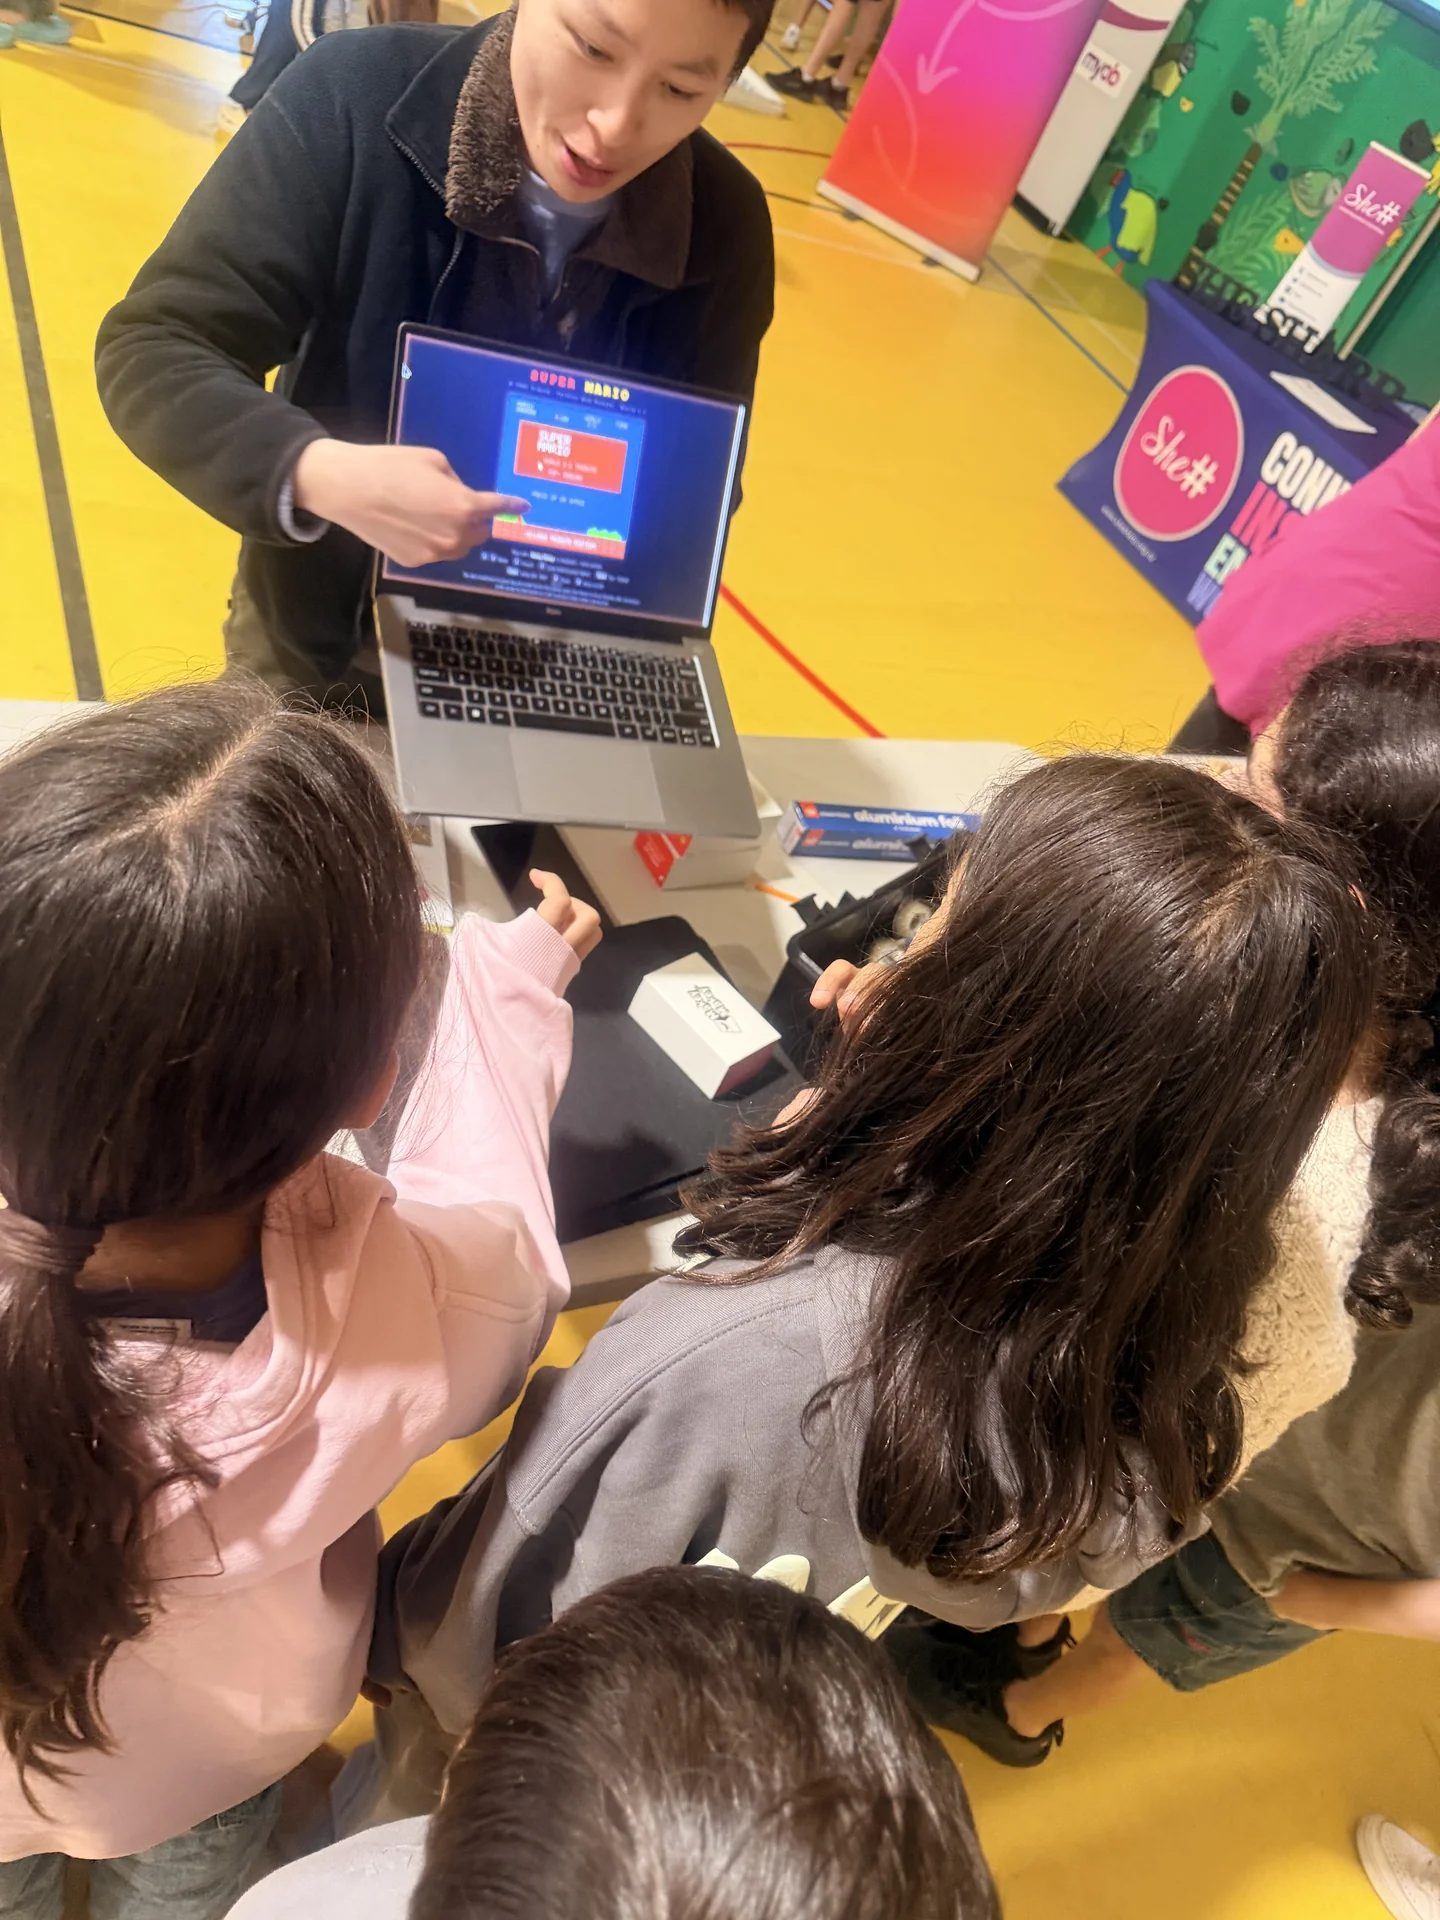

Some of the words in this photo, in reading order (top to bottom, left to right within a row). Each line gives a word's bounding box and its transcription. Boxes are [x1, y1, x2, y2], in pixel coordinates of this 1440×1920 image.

[530, 369, 576, 390] SUPER
[584, 380, 630, 402] MARIO
[853, 809, 939, 828] aluminium
